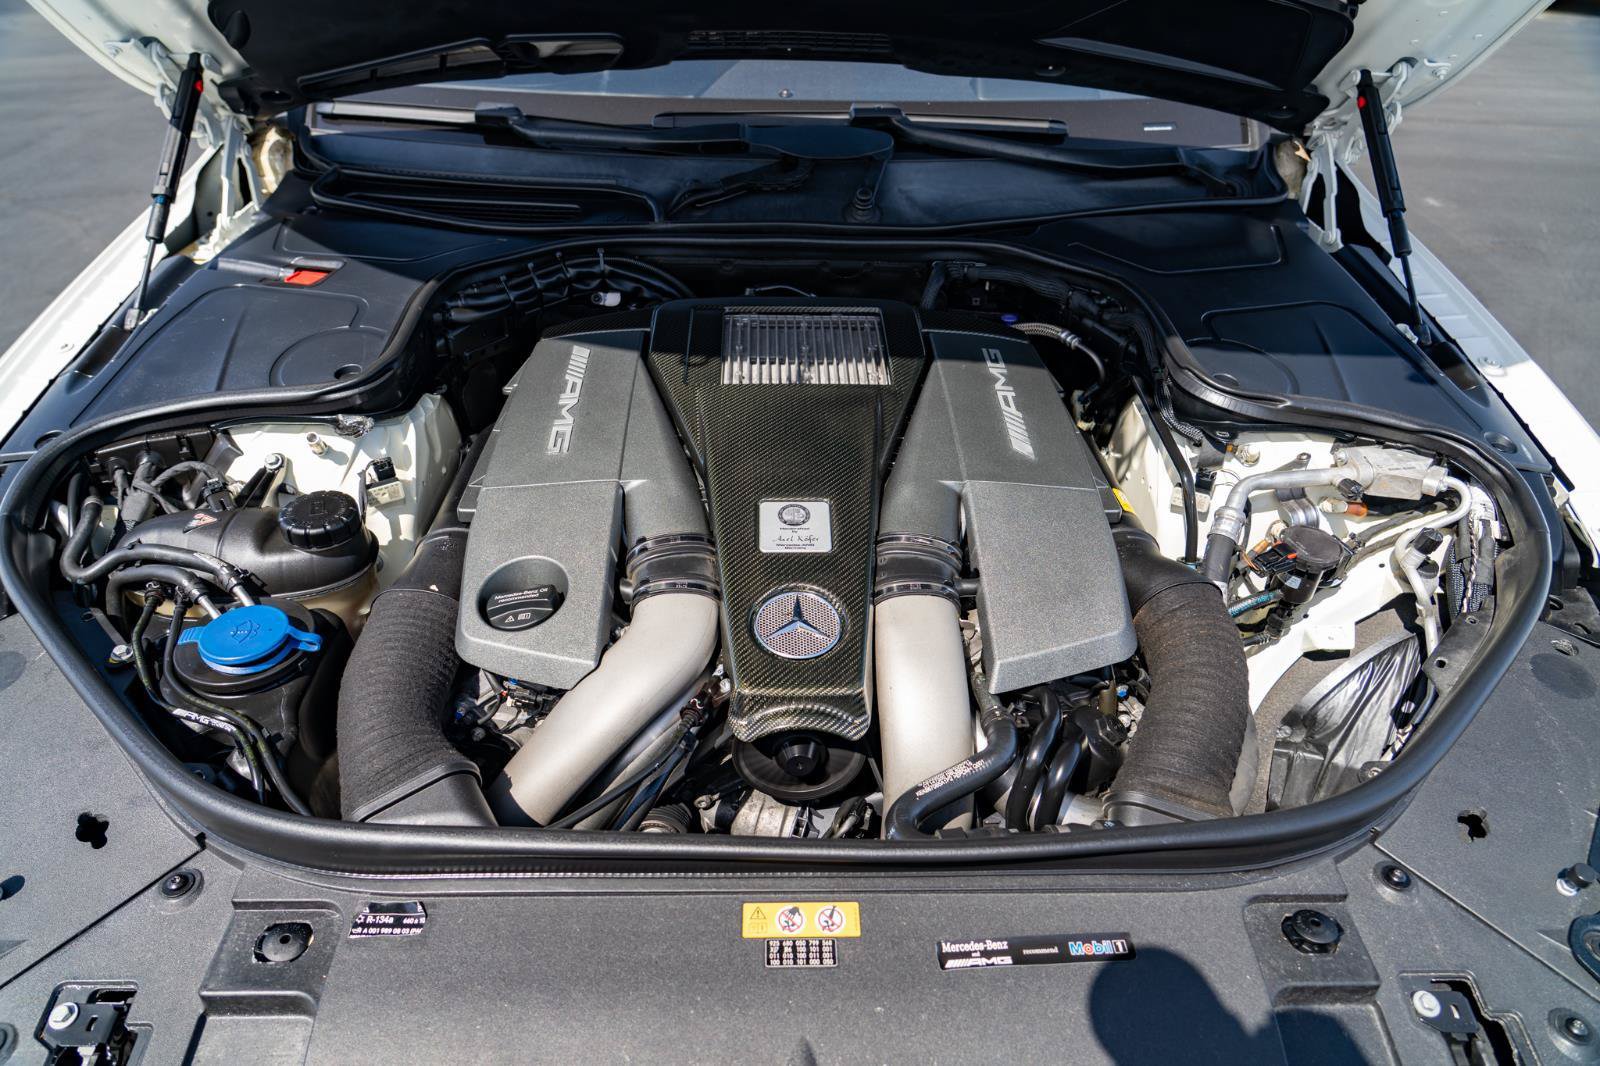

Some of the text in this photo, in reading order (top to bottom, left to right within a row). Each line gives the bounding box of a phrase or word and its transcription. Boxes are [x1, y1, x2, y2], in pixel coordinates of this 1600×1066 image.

[545, 373, 583, 454] AMG
[366, 915, 394, 924] R-134a
[942, 940, 1008, 953] Mercedes-Benz
[1068, 940, 1114, 956] Mobil
[967, 956, 1013, 967] AMG
